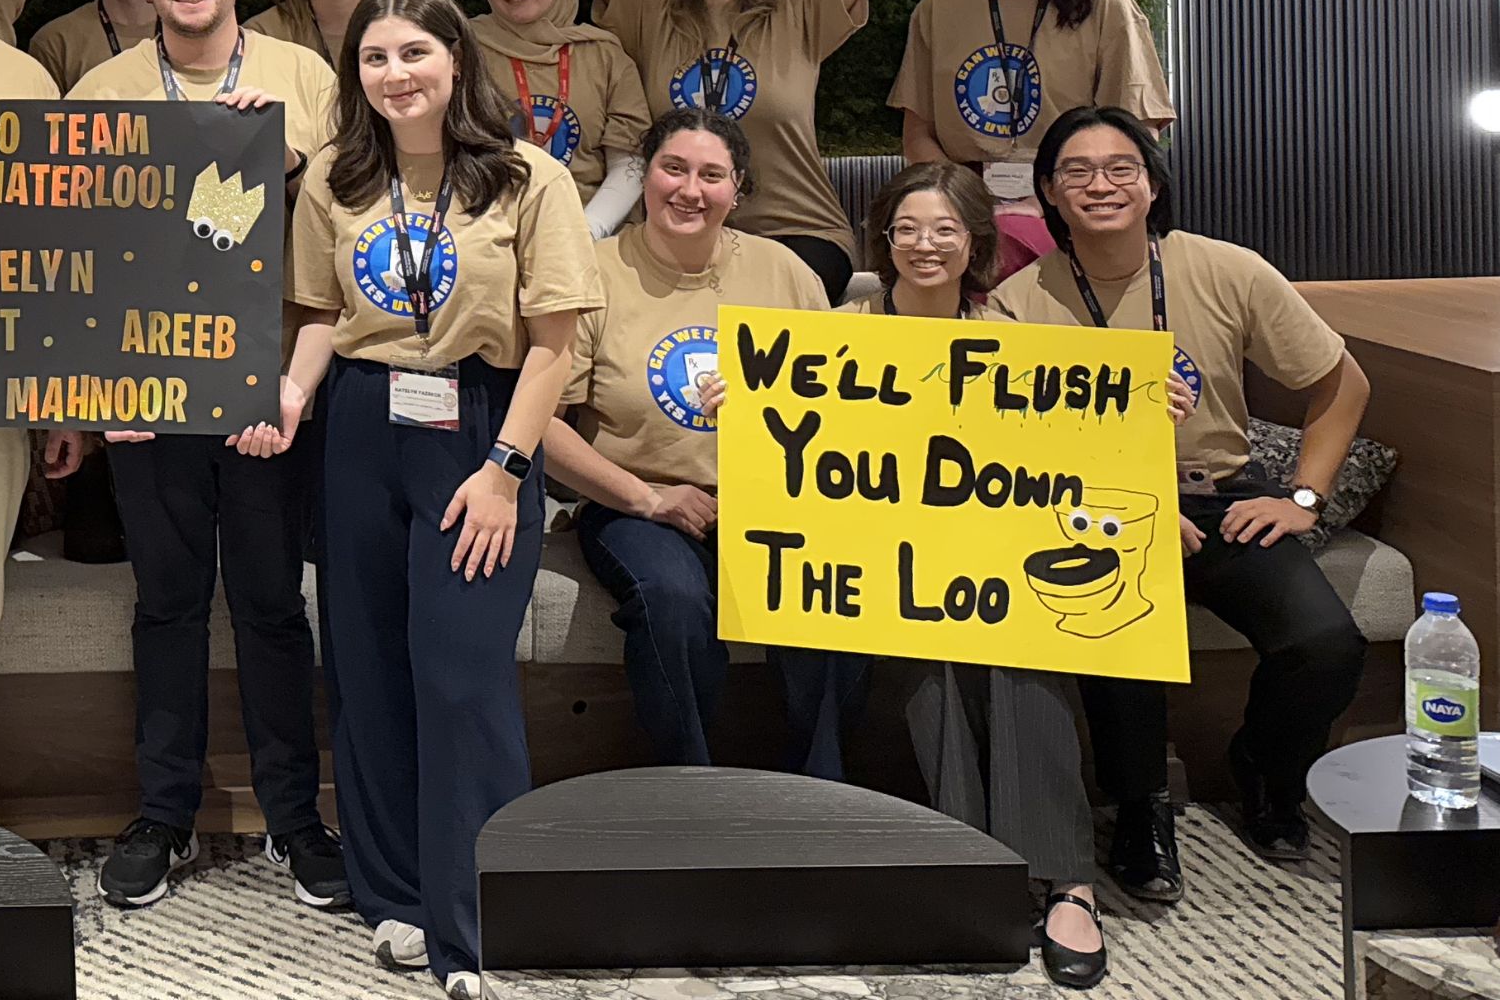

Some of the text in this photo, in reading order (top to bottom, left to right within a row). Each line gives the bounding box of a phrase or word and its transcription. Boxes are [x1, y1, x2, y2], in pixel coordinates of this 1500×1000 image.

[738, 61, 755, 81] IT?
[957, 52, 984, 80] CAN
[44, 112, 150, 156] TEAM
[960, 99, 980, 129] YES,
[1017, 102, 1039, 132] CAN!
[357, 223, 386, 254] CAN
[437, 230, 455, 256] IT?
[360, 274, 388, 309] YES,
[121, 309, 237, 359] AREEB
[649, 339, 675, 370] CAN
[672, 329, 701, 343] WE
[737, 323, 1131, 413] WE'LL FLUSH
[6, 375, 188, 423] MAHNOOR
[658, 390, 688, 425] YES,
[762, 406, 901, 504] YOU
[744, 530, 1010, 625] THE LOO
[1425, 701, 1462, 716] NAYA
